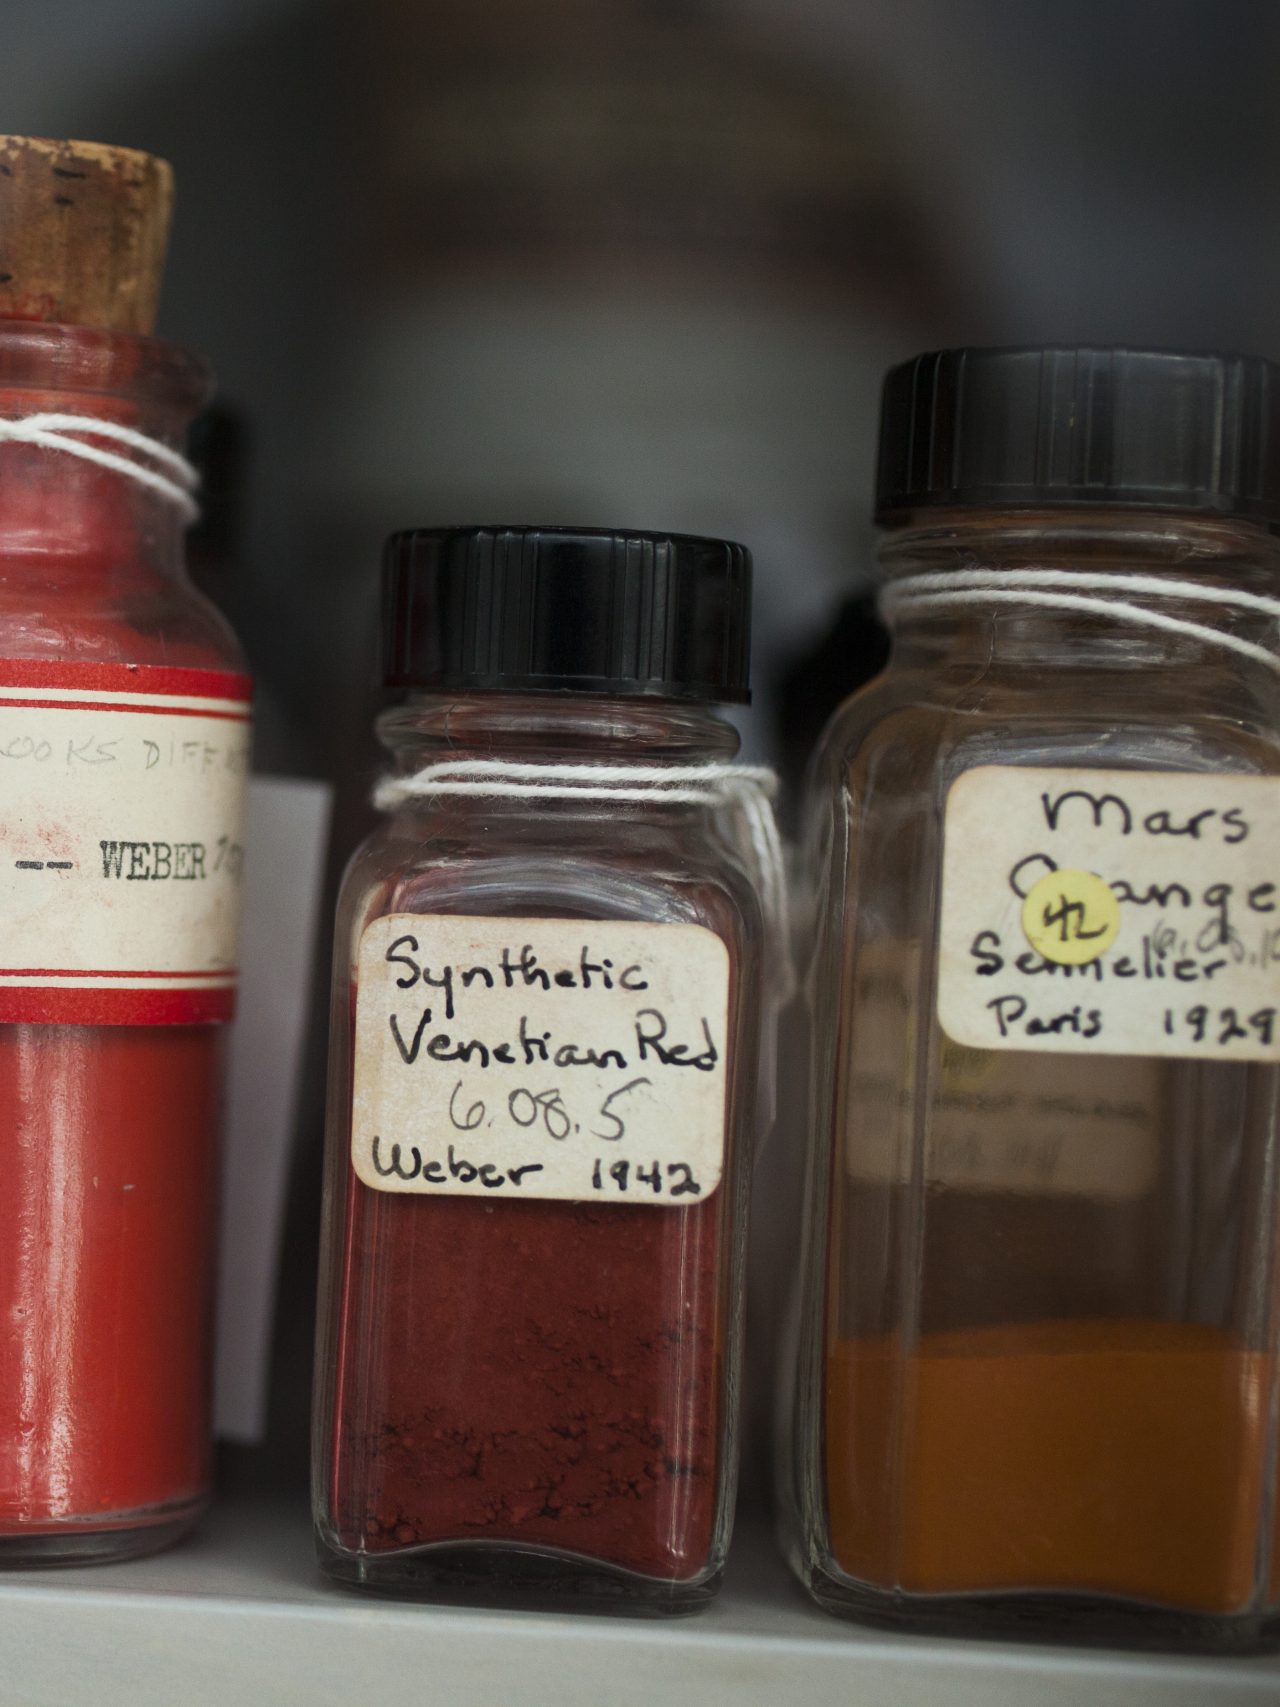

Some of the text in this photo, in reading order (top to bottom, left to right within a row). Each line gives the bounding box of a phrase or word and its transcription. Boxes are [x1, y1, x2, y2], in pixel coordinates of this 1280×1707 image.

[1041, 790, 1250, 844] Mars
[99, 839, 207, 883] WEBER
[1008, 853, 1277, 945] Oange
[1042, 893, 1109, 942] 42
[385, 934, 649, 1020] Synthetic
[389, 1008, 718, 1072] Venetian Red
[986, 994, 1277, 1046] Paris 1929
[371, 1134, 701, 1196] Weber 1942
